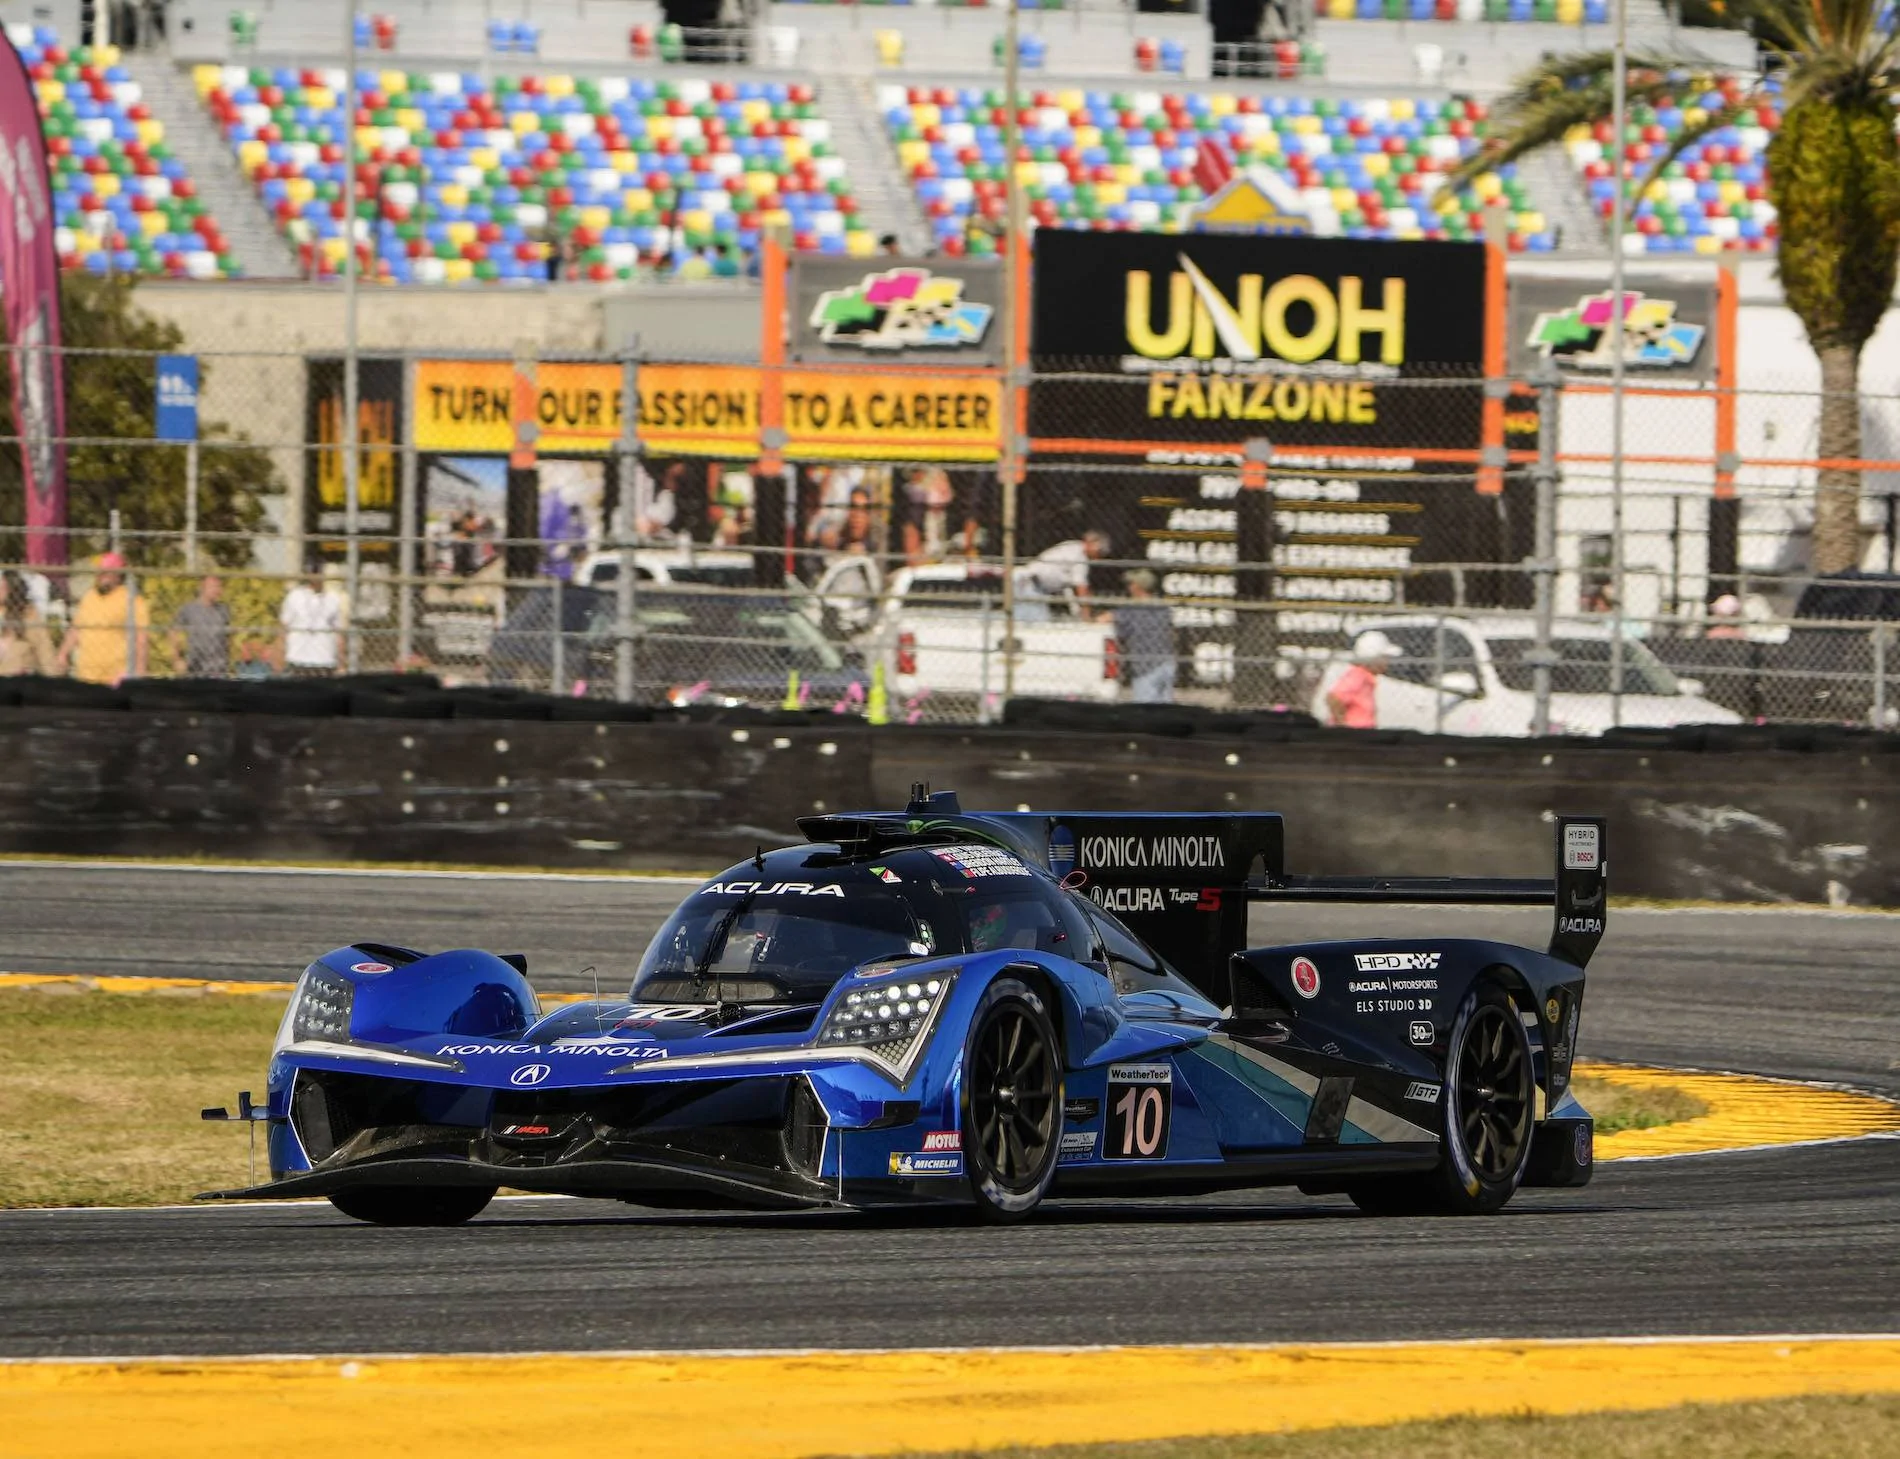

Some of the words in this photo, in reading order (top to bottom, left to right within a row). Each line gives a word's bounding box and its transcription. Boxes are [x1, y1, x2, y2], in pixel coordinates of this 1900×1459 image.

[1126, 266, 1406, 364] UNOH
[1148, 371, 1378, 424] FANZONE
[430, 385, 511, 422] TURN
[538, 389, 602, 425] OUR
[838, 396, 859, 429] A
[868, 393, 990, 430] CAREER
[1080, 836, 1148, 868] KONICA
[1151, 836, 1225, 868] MINOLTA
[700, 882, 846, 898] ACURA
[1104, 887, 1165, 912] ACURA
[1168, 888, 1199, 904] Type
[1195, 887, 1222, 912] S
[1566, 918, 1602, 933] ACURA
[1357, 956, 1402, 969] HPD
[1356, 982, 1388, 991] ACURA
[1392, 979, 1438, 990] MOTORSPORTS
[1356, 1001, 1374, 1013] ELS
[1378, 1000, 1415, 1012] STUDIO
[1418, 999, 1433, 1010] 3D
[436, 1044, 541, 1056] KONICA
[547, 1045, 668, 1059] MINOLTA
[1111, 1069, 1169, 1079] WeatherTech
[1415, 1086, 1438, 1099] GTP
[1116, 1087, 1163, 1155] 10
[924, 1133, 961, 1149] MOTUL
[914, 1159, 959, 1169] MICHELIN
